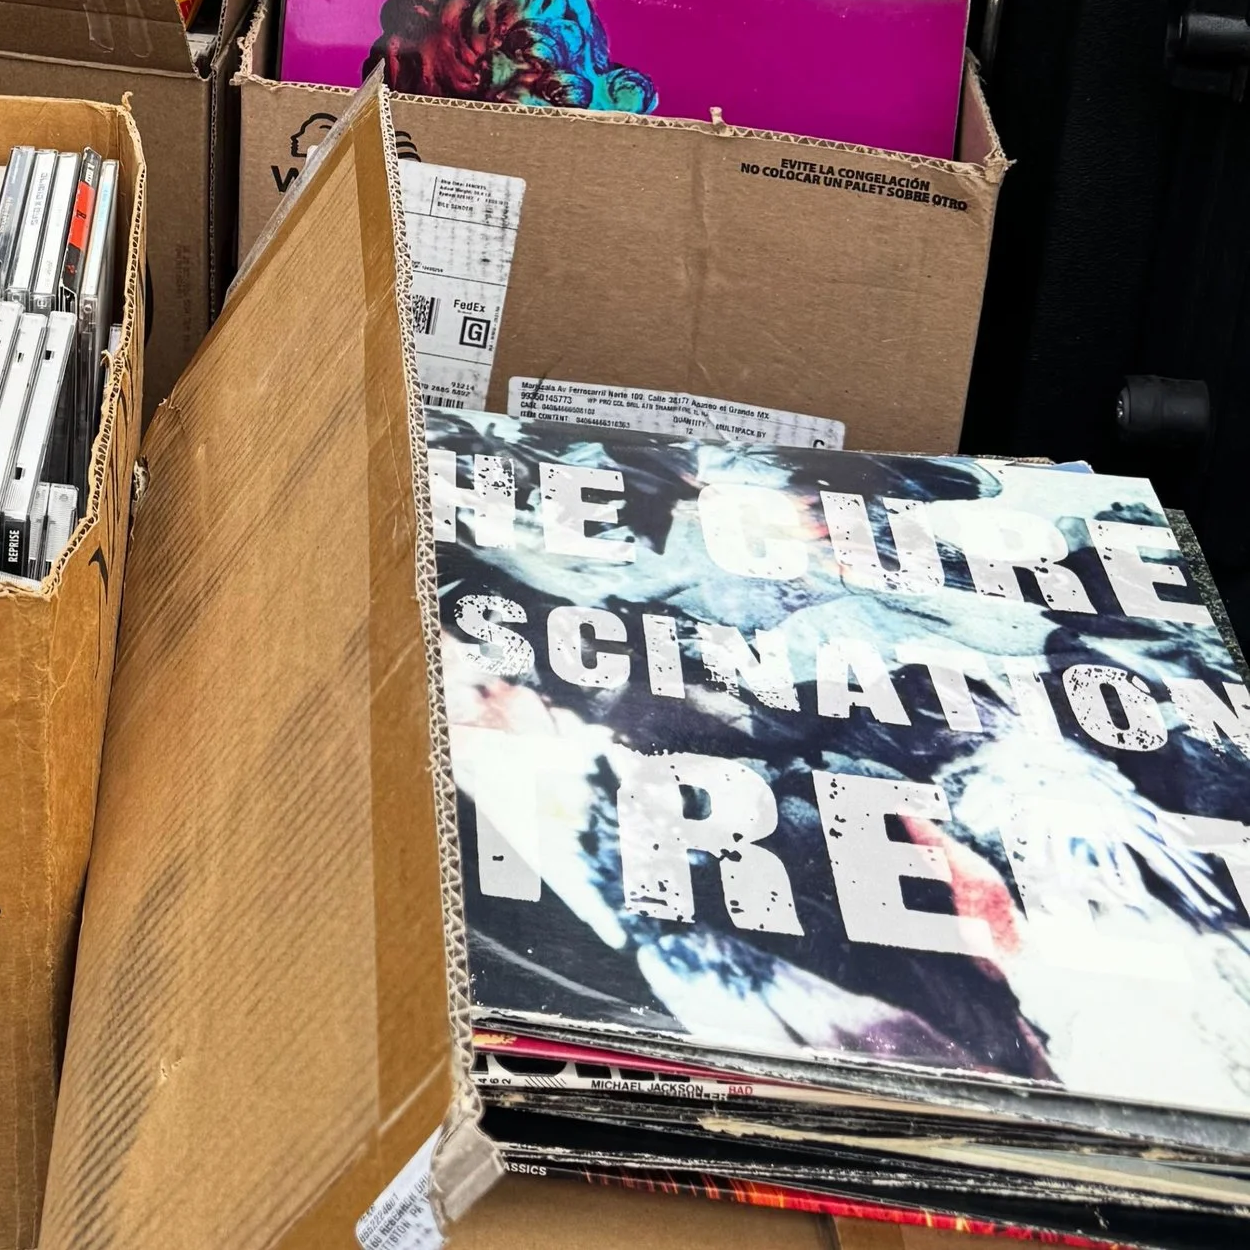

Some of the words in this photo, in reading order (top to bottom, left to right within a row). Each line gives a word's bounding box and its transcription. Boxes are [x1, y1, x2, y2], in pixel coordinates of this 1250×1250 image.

[740, 162, 760, 175] NO
[762, 166, 821, 185] COLOCAR
[823, 176, 843, 189] UN
[845, 179, 885, 195] PALET
[887, 187, 930, 203] SOBRE
[932, 194, 967, 211] OTRO
[781, 158, 816, 173] EVITE
[819, 165, 835, 176] LA
[838, 167, 930, 191] CONGELACIÓN
[453, 299, 486, 313] FedEx
[467, 322, 484, 343] G
[8, 530, 20, 562] REPRISE
[427, 448, 636, 566] HE
[697, 482, 1213, 626] CURE
[451, 592, 1250, 762] SCINATION
[591, 1079, 644, 1093] MICHAEL
[647, 1082, 704, 1094] JACKSON
[728, 1084, 754, 1096] BAD
[502, 1161, 547, 1177] ASSICS
